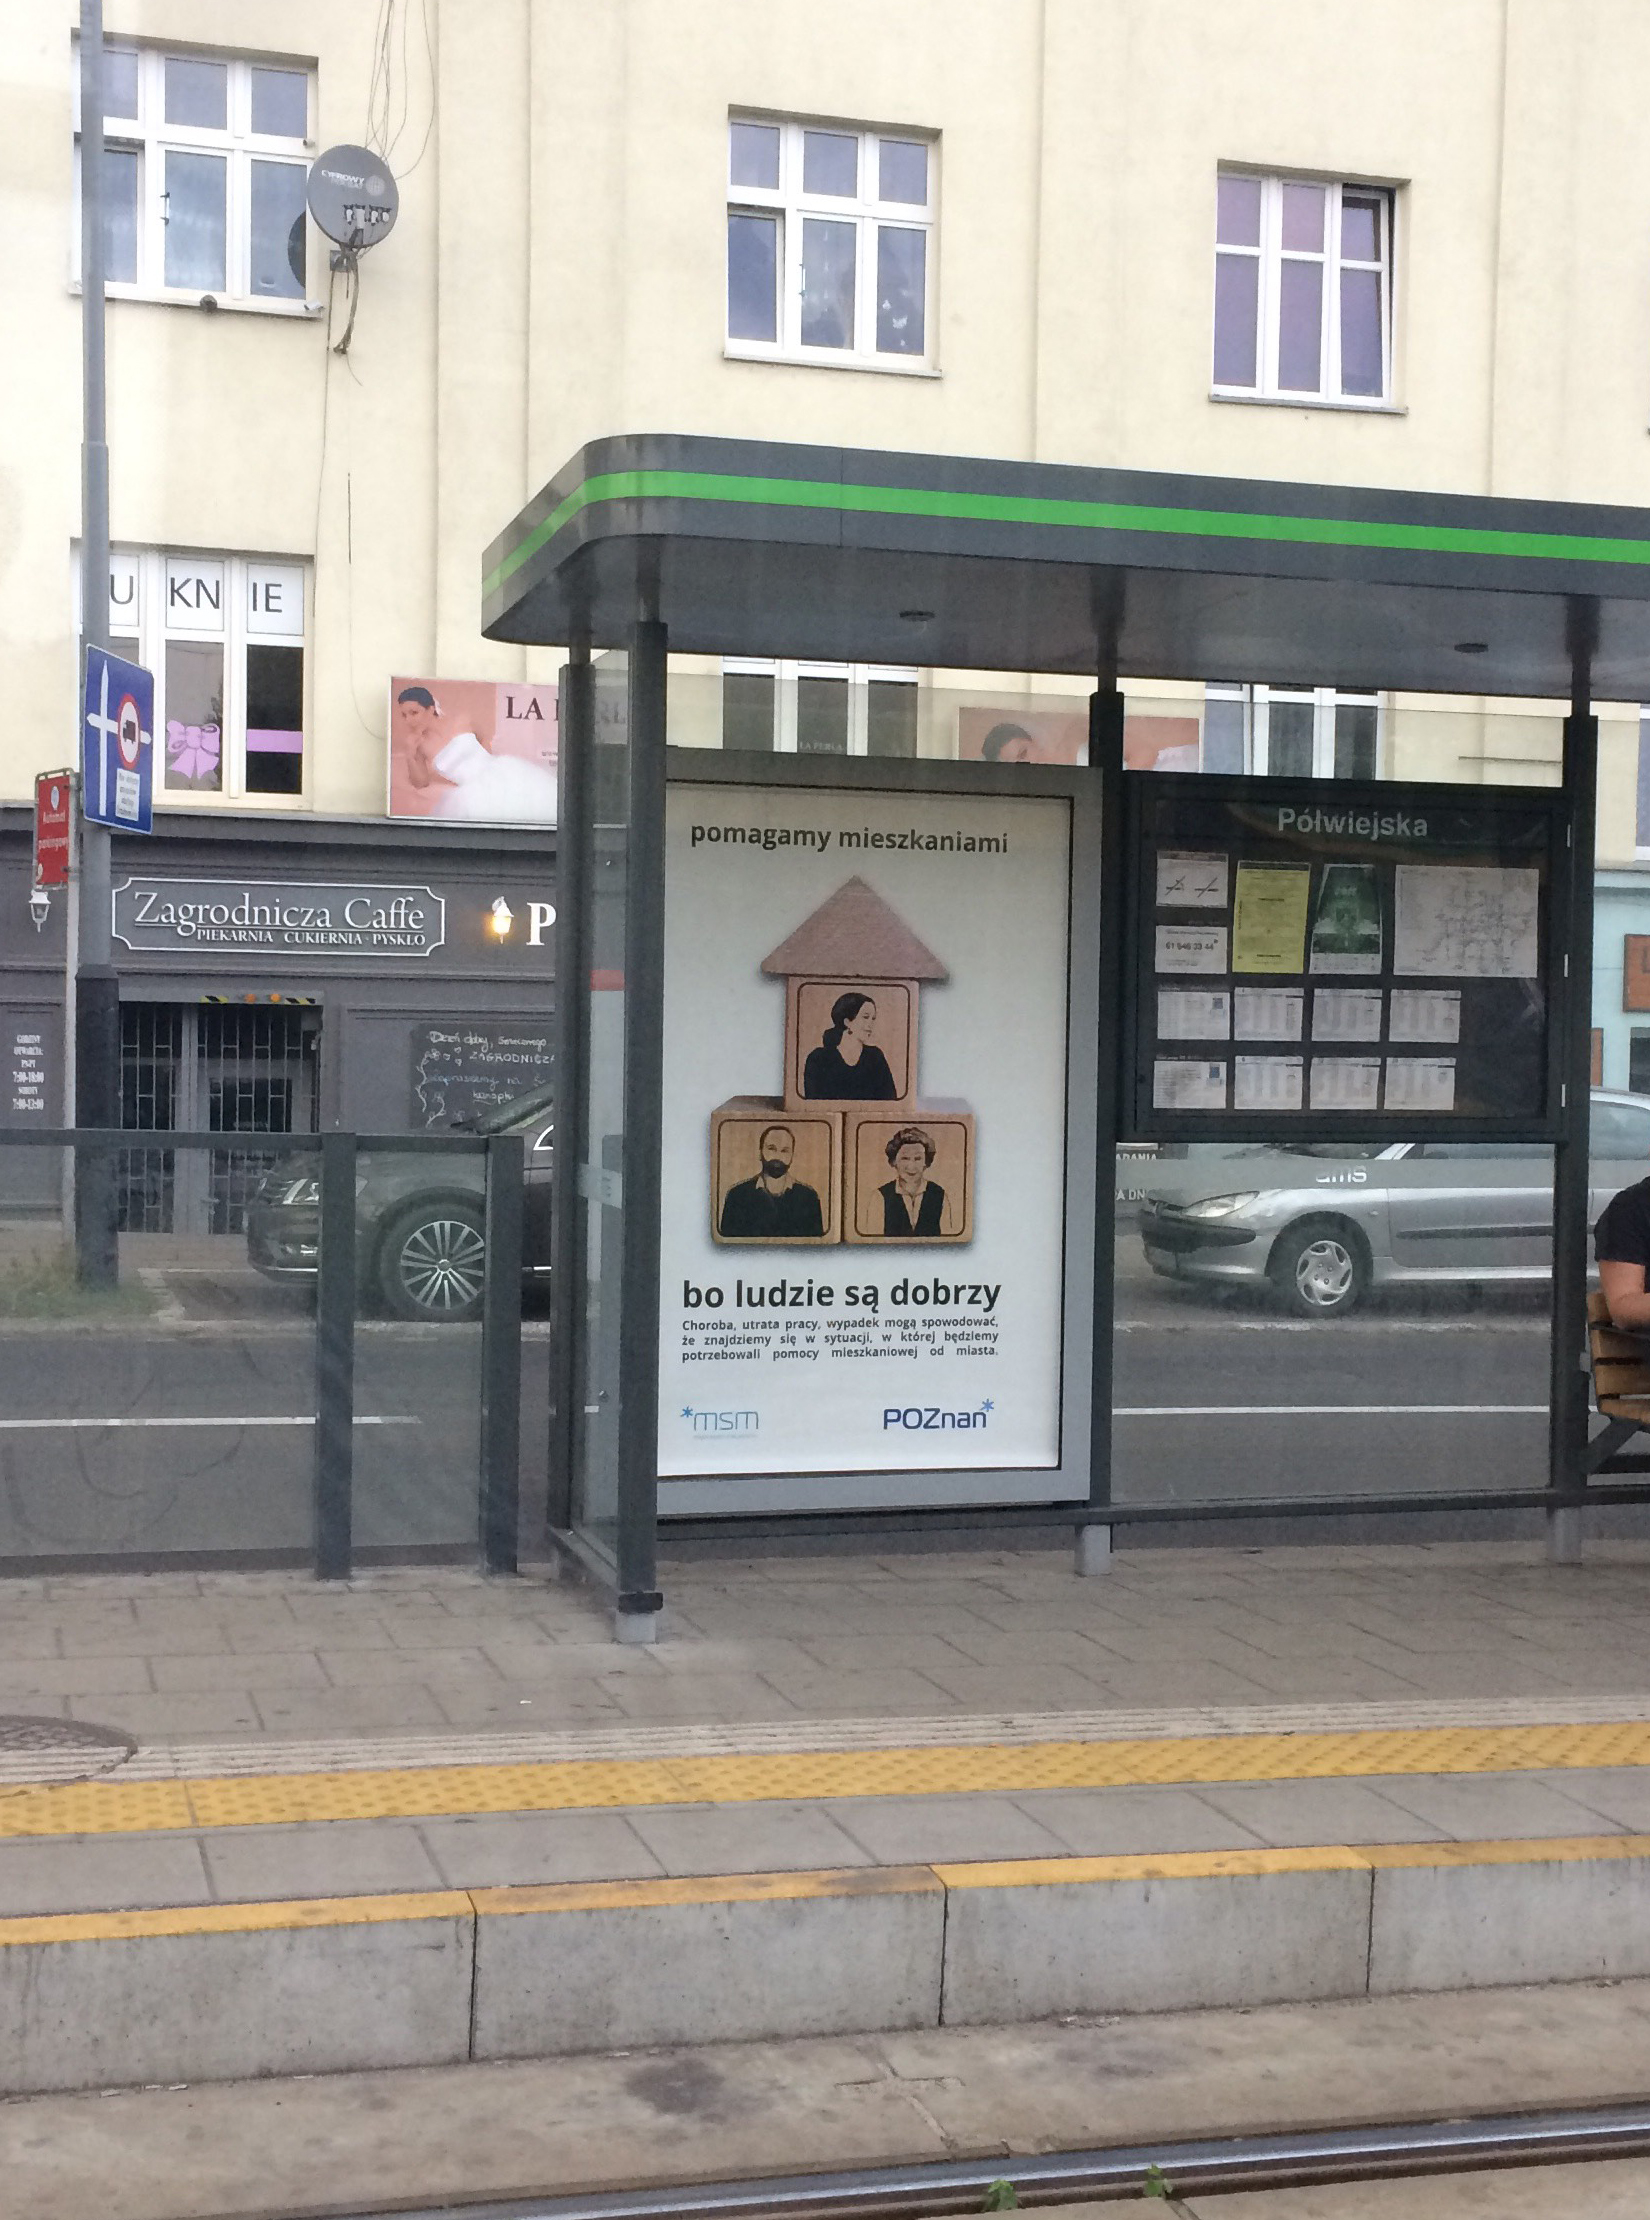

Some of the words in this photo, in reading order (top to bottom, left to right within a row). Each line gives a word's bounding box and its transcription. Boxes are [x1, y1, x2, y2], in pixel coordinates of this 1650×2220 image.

[505, 695, 546, 721] LA
[690, 821, 832, 854] pomagamy
[839, 826, 1008, 853] mieszkaniami
[1278, 808, 1428, 841] Półwiejska
[134, 891, 333, 938] Zagrodnicza
[345, 896, 426, 930] Caffe
[196, 928, 274, 943] PIEKARNIA
[284, 931, 363, 946] CUKIERNIA
[683, 1280, 724, 1308] bo
[736, 1279, 834, 1307] ludzie
[844, 1284, 879, 1313] są
[890, 1278, 1002, 1312] dobrzy
[682, 1320, 737, 1332] Choroba,
[742, 1319, 780, 1330] utrata
[785, 1319, 822, 1332] pracy,
[826, 1316, 880, 1331] wypadek
[884, 1317, 917, 1330] mogą
[921, 1315, 999, 1329] spowodować,
[682, 1334, 696, 1346] że
[704, 1334, 772, 1348] znajdziemy
[780, 1334, 797, 1347] się
[824, 1333, 873, 1347] sytuacji,
[881, 1335, 893, 1343] w
[900, 1331, 936, 1346] której
[944, 1331, 999, 1345] będziemy
[682, 1349, 761, 1362] potrzebowali
[772, 1349, 820, 1361] pomocy
[831, 1346, 919, 1360] mieszkaniowej
[929, 1346, 945, 1357] od
[956, 1345, 999, 1357] miasta.
